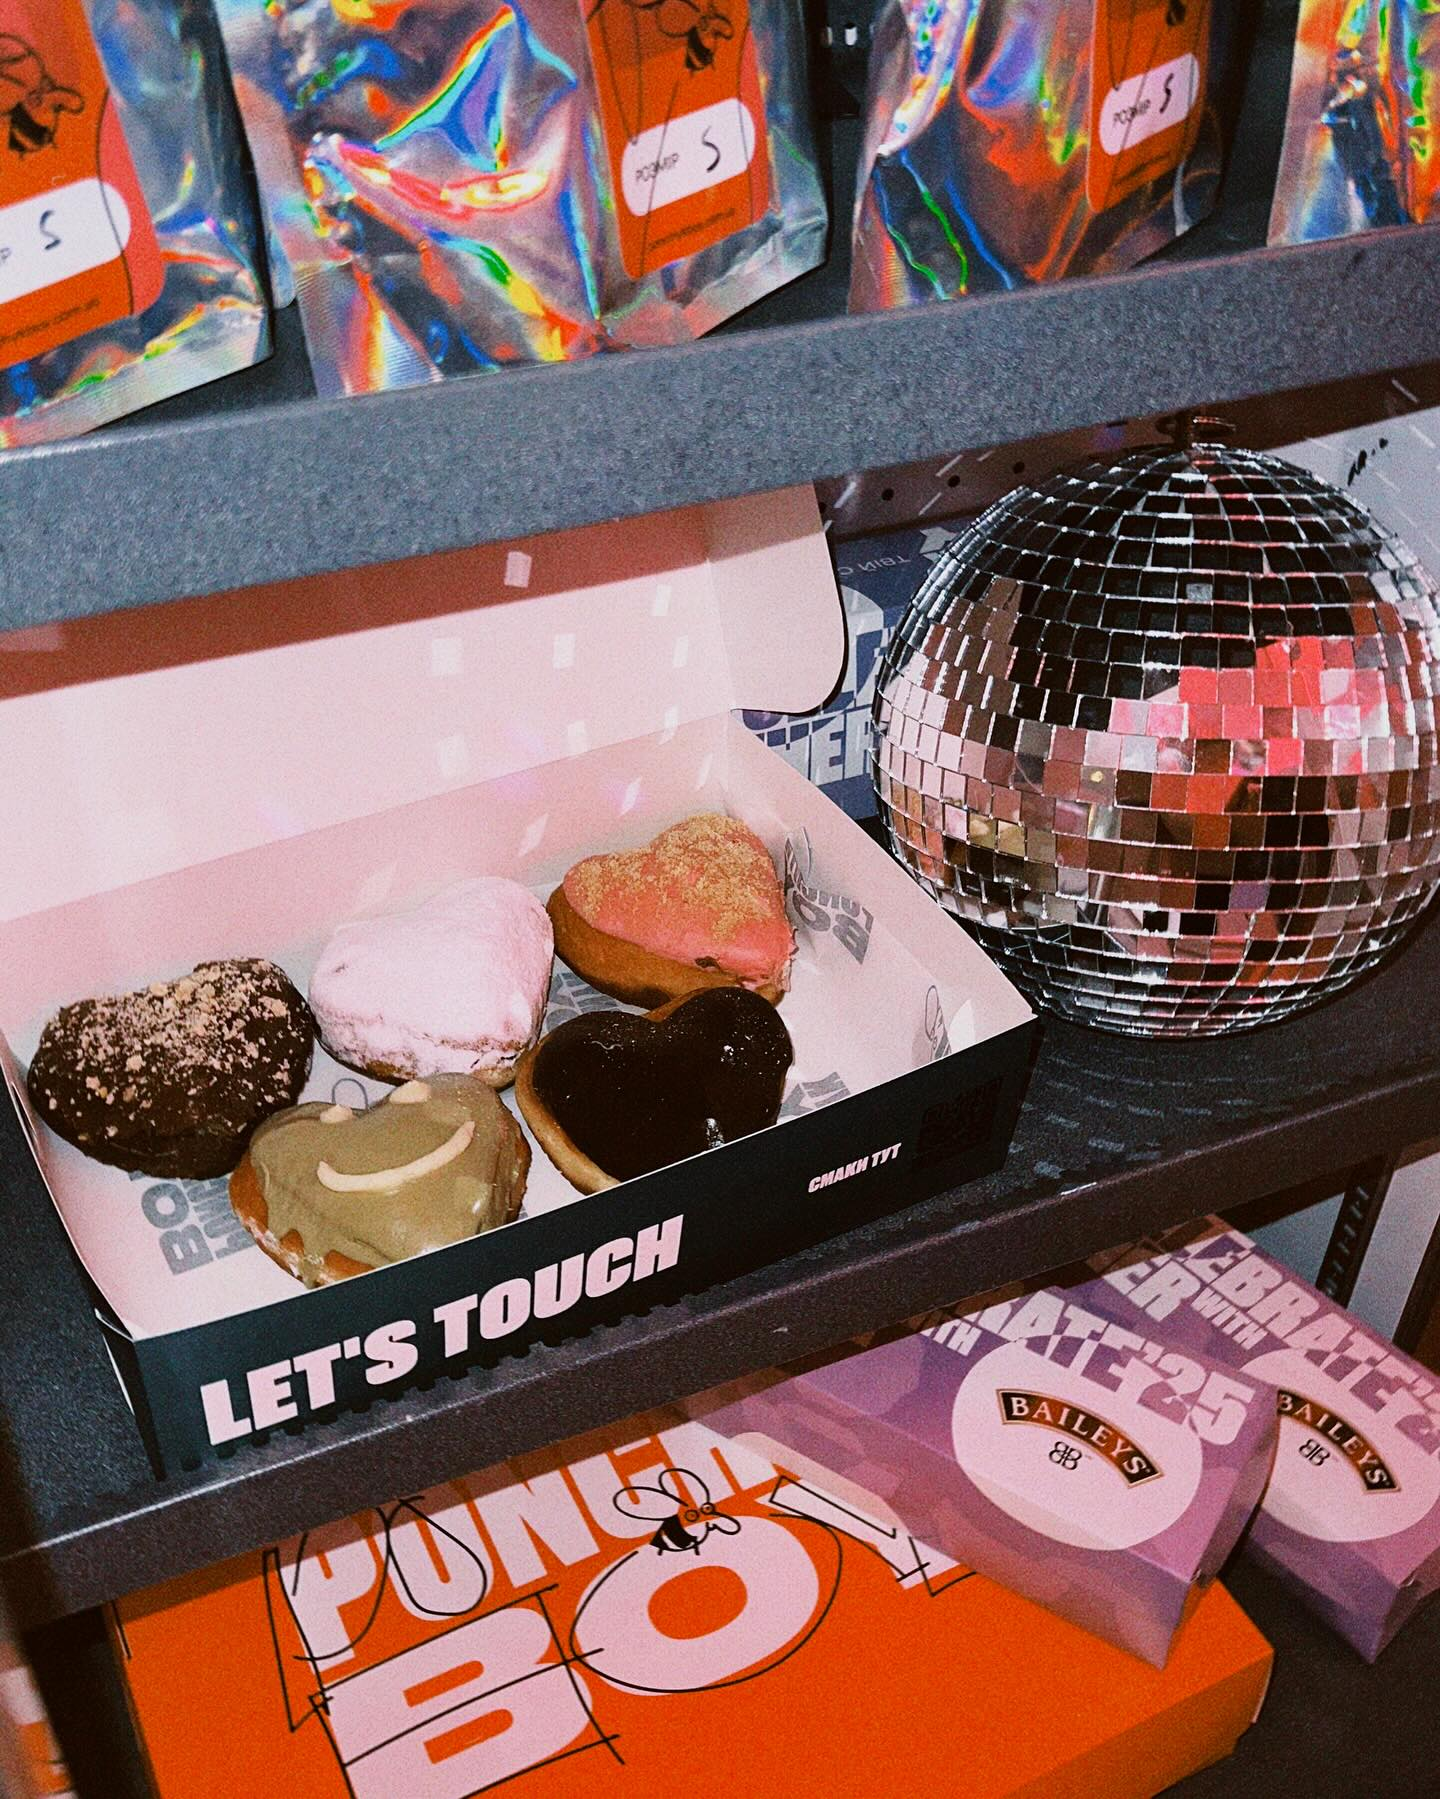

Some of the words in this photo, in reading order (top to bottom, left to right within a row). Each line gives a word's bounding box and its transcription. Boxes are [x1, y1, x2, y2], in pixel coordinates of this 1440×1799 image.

[808, 1156, 869, 1193] СМАКИ
[871, 1142, 902, 1168] ТУТ
[200, 1319, 418, 1446] LET'S
[434, 1214, 684, 1358] TOUCH
[1103, 1253, 1201, 1323] ER
[1190, 1284, 1269, 1351] WITH
[1011, 1395, 1149, 1476] BAILEYS
